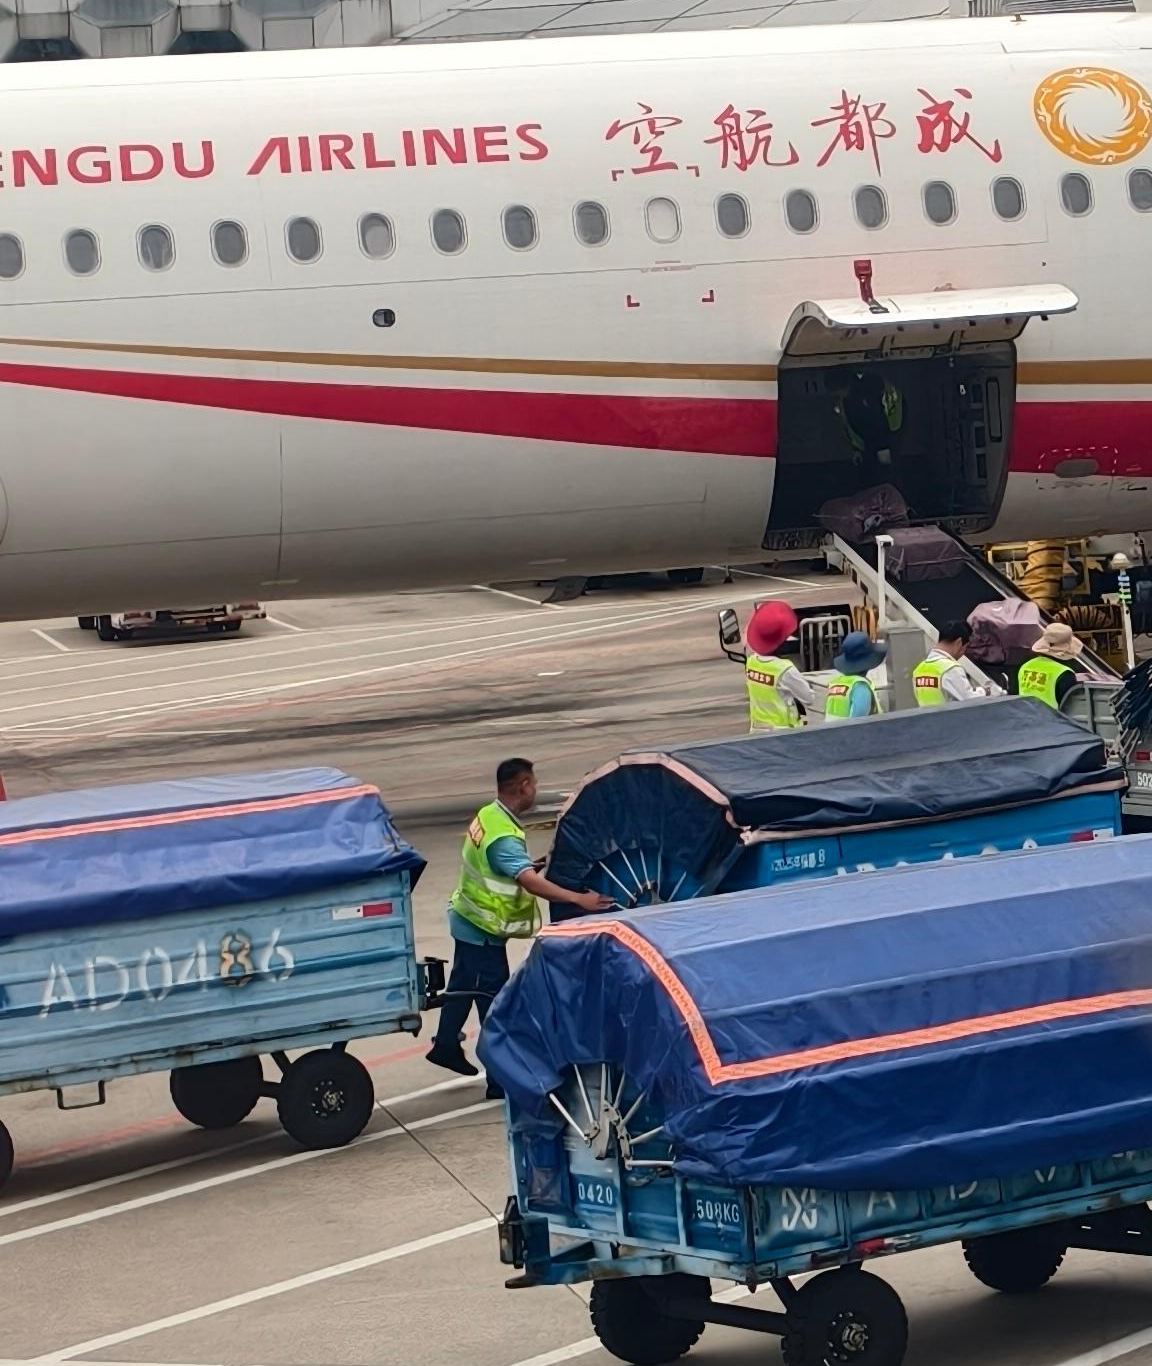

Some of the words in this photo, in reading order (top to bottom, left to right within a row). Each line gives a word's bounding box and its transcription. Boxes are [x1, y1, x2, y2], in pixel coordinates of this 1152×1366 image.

[0, 140, 215, 188] NGDU
[247, 123, 549, 176] AIRLINES
[38, 928, 295, 1019] AD0486
[577, 1182, 613, 1206] 0420
